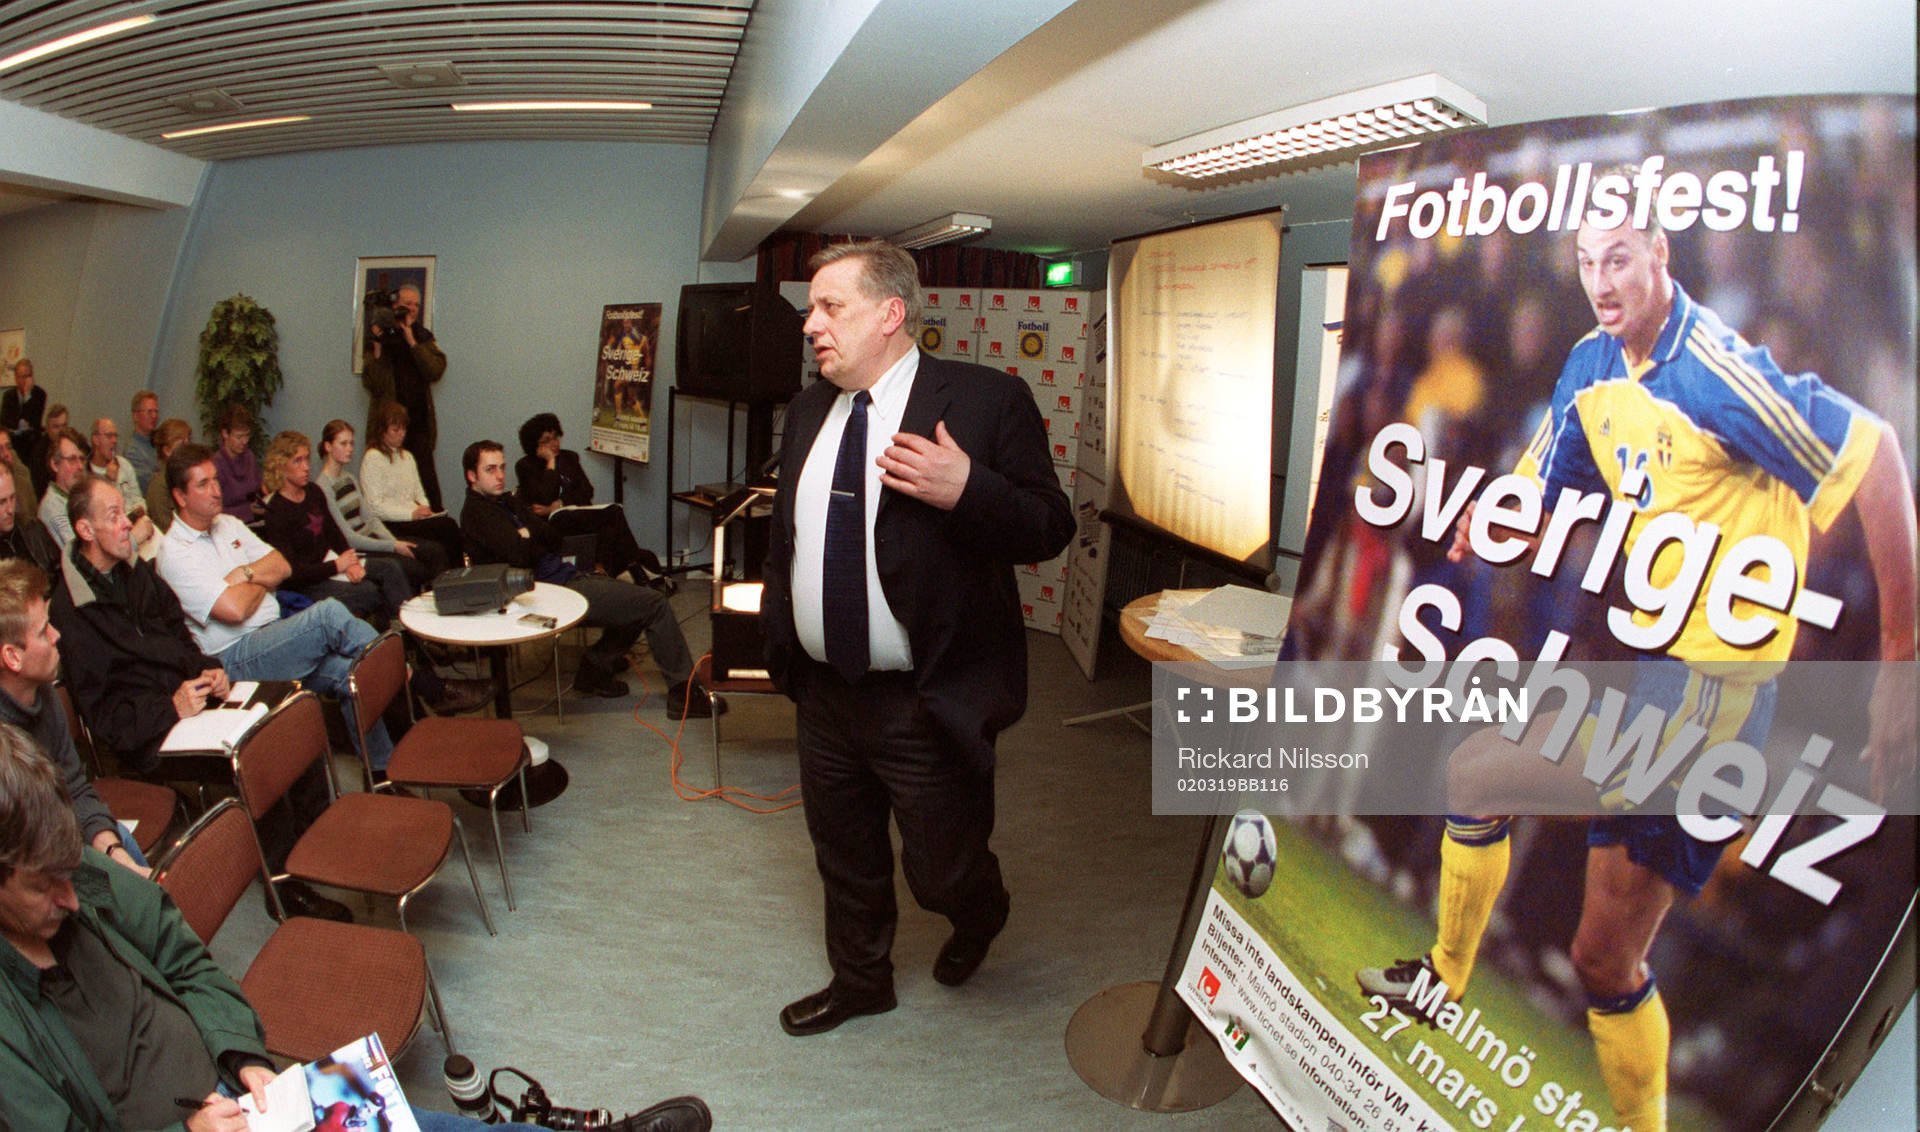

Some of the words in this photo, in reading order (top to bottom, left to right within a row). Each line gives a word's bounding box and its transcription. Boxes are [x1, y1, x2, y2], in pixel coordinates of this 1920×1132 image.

[1376, 150, 1805, 242] Fotbollsfest!
[606, 365, 650, 383] Schweiz
[1017, 320, 1049, 331] Fotboll
[1355, 422, 1844, 651] Sverige-
[1382, 584, 1887, 906] Schweiz
[1202, 939, 1238, 987] Internet:
[1299, 1056, 1371, 1132] Information:
[1207, 923, 1247, 973] Biljetter:
[1247, 970, 1277, 1012] Malmö
[1279, 1012, 1318, 1056] stadion
[1320, 1055, 1362, 1099] 040-34
[1363, 1098, 1381, 1119] 26
[1213, 904, 1244, 945] Missa
[1245, 938, 1265, 969] inte
[1264, 964, 1346, 1058] landskampen
[1347, 1052, 1383, 1091] inför
[1384, 1085, 1409, 1116] VM
[1359, 995, 1412, 1042] 27
[1407, 1039, 1498, 1129] mars
[1406, 966, 1537, 1088] Malmö
